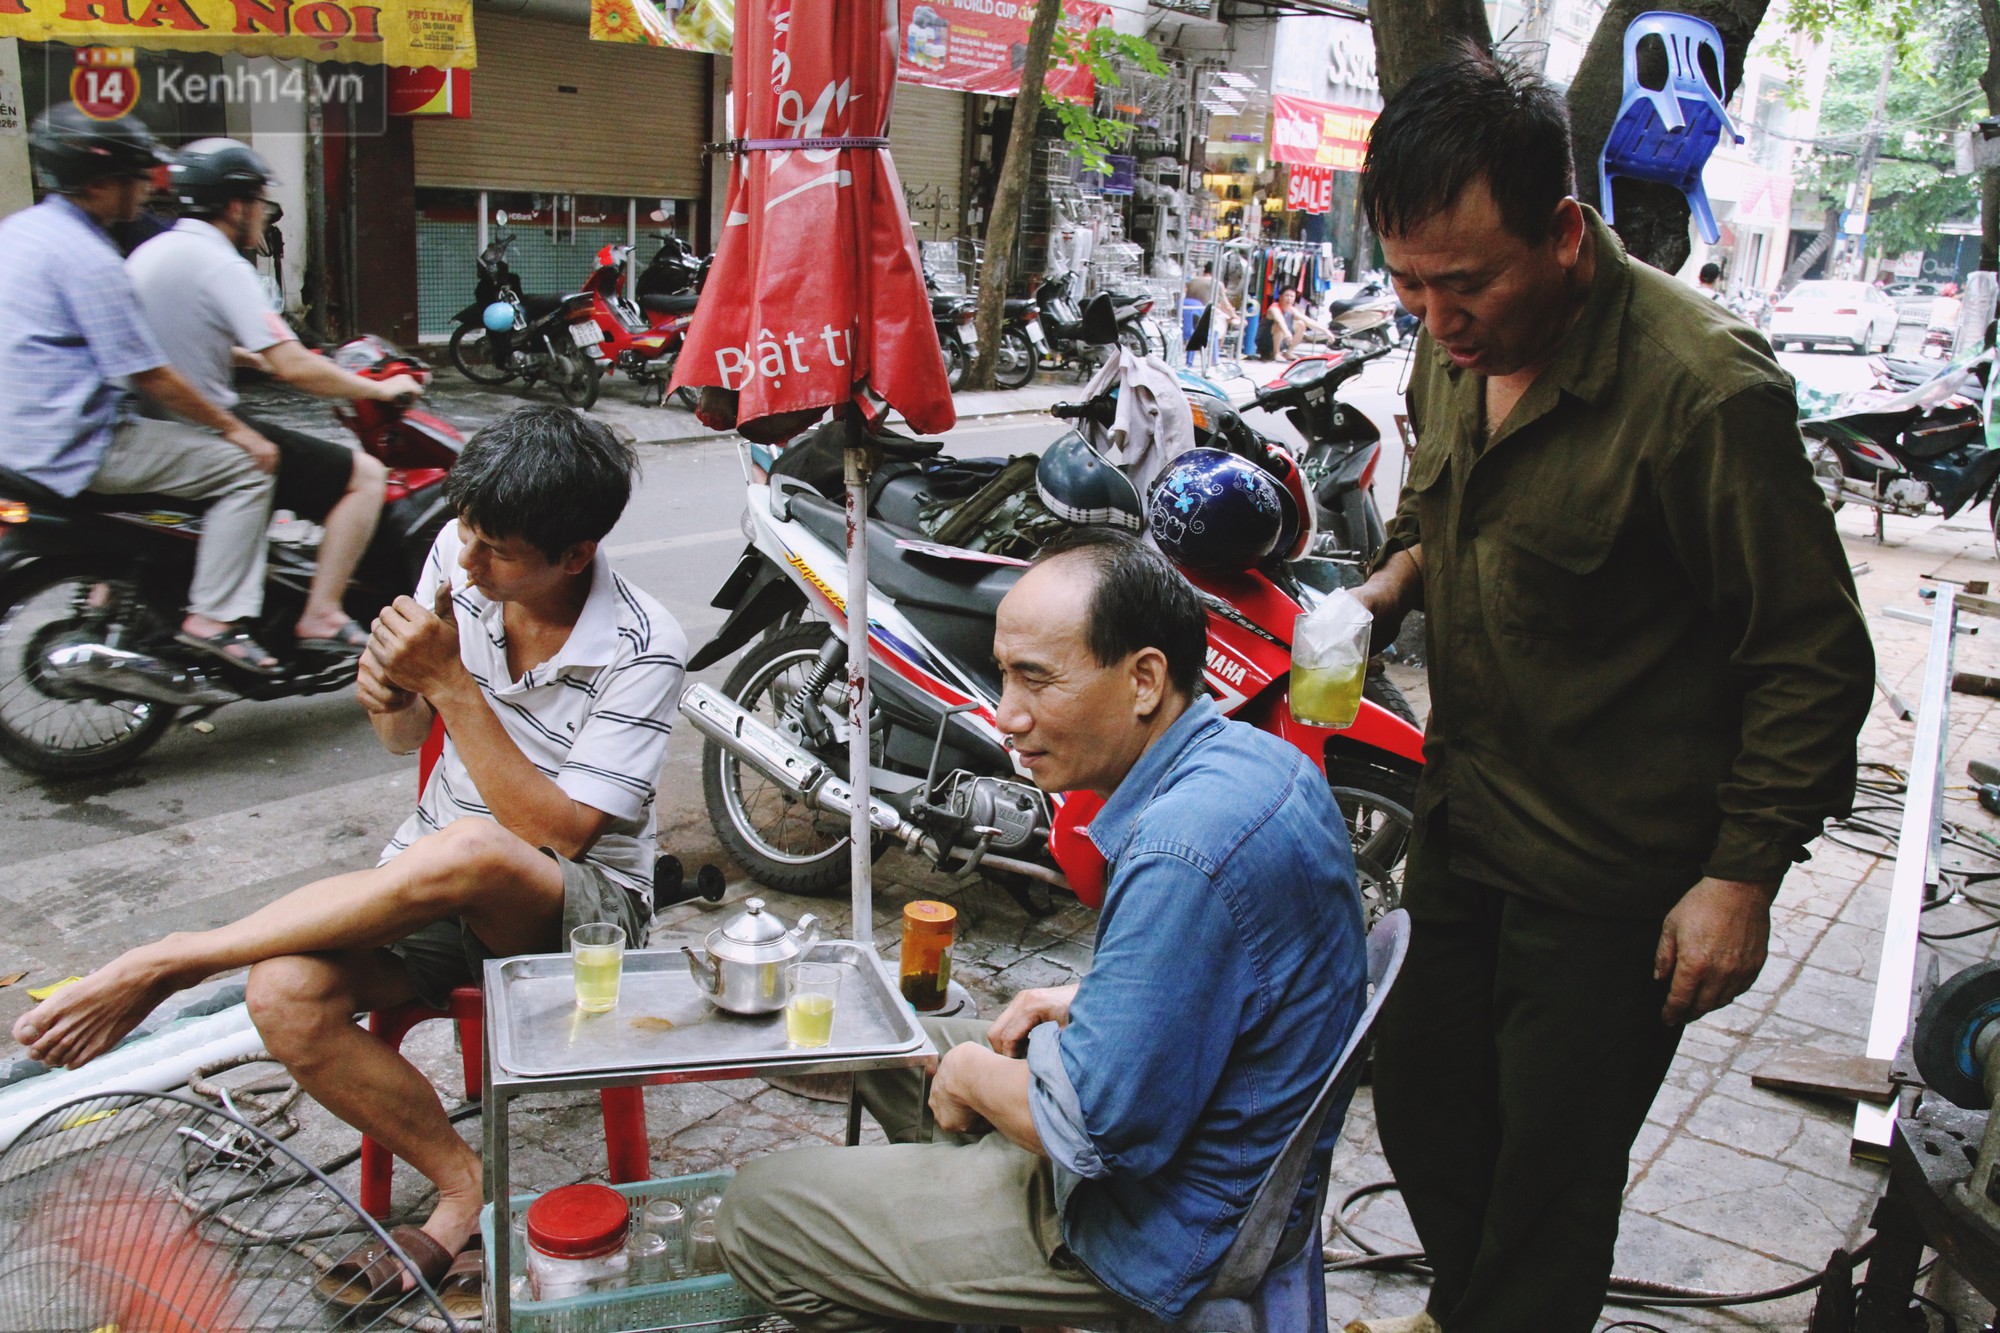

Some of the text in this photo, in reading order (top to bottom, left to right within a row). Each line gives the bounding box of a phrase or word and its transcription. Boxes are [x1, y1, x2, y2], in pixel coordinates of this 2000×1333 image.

[953, 0, 994, 14] WORLD
[995, 1, 1017, 19] CUP
[1288, 174, 1331, 211] SALE
[508, 213, 533, 221] HDBank
[578, 215, 601, 223] HDBank
[714, 328, 810, 391] Bật
